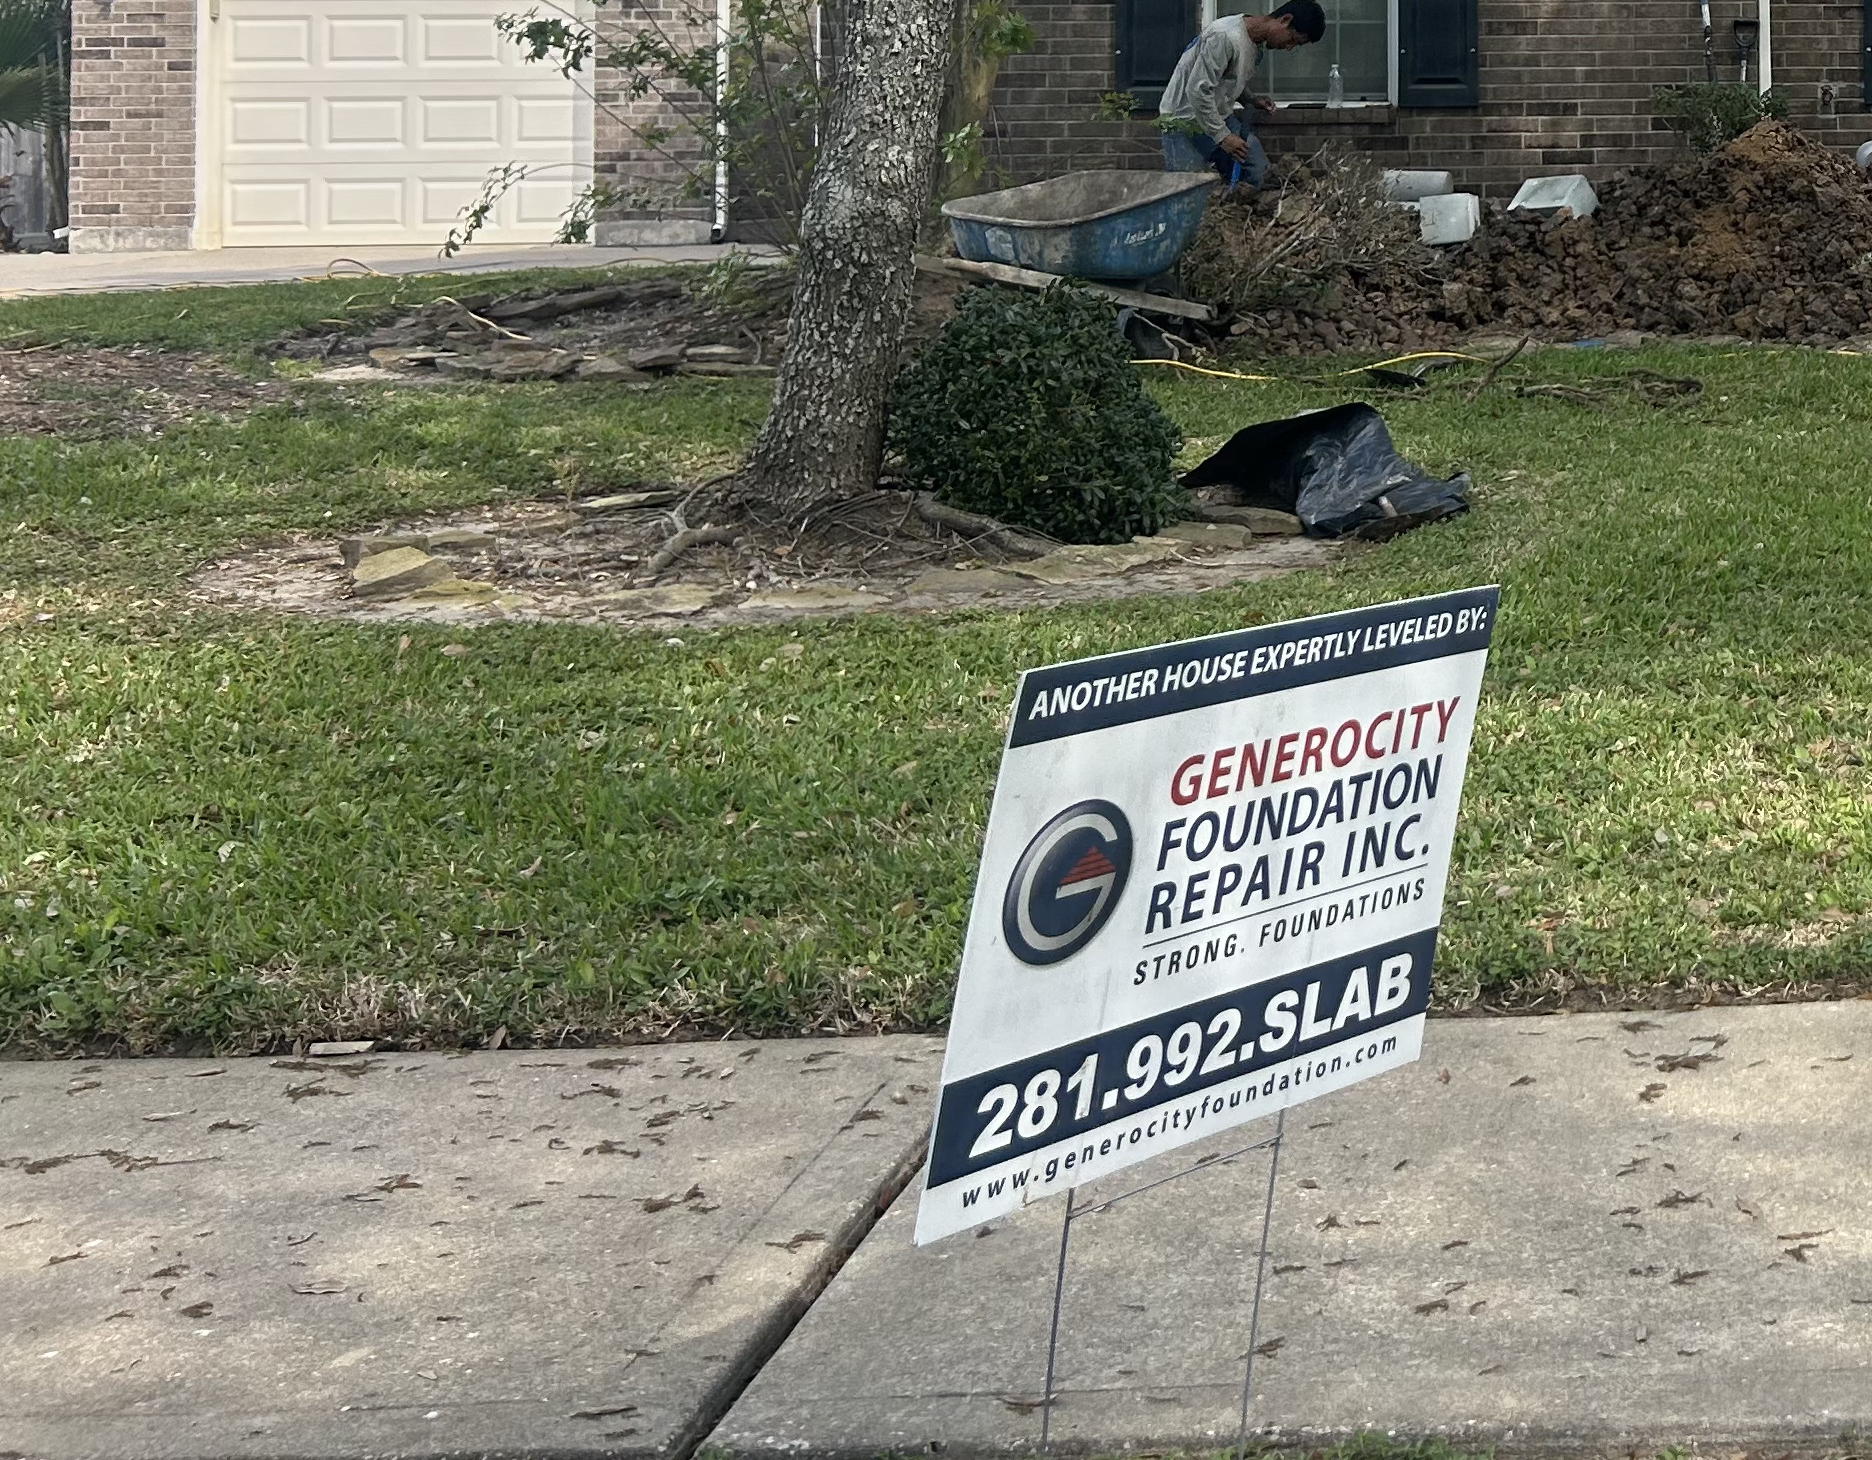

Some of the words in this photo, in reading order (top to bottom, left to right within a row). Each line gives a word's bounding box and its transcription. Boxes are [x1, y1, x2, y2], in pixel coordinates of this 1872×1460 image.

[1028, 668, 1159, 721] ANOTHER
[1161, 649, 1249, 693] HOUSE
[1249, 628, 1362, 675] EXPERTLY
[1362, 612, 1454, 653] LEVELED
[1455, 605, 1488, 635] BY:
[1170, 695, 1461, 807] GENEROCITY
[1156, 753, 1443, 872] FOUNDATION
[1133, 932, 1245, 986] STRONG.
[1258, 877, 1426, 948] FOUNDATIONS
[1144, 840, 1326, 935] REPAIR
[1342, 812, 1430, 878] INC.
[968, 951, 1414, 1159] 281.992.SLAB
[961, 1034, 1398, 1209] www.generocityfoundation.com
